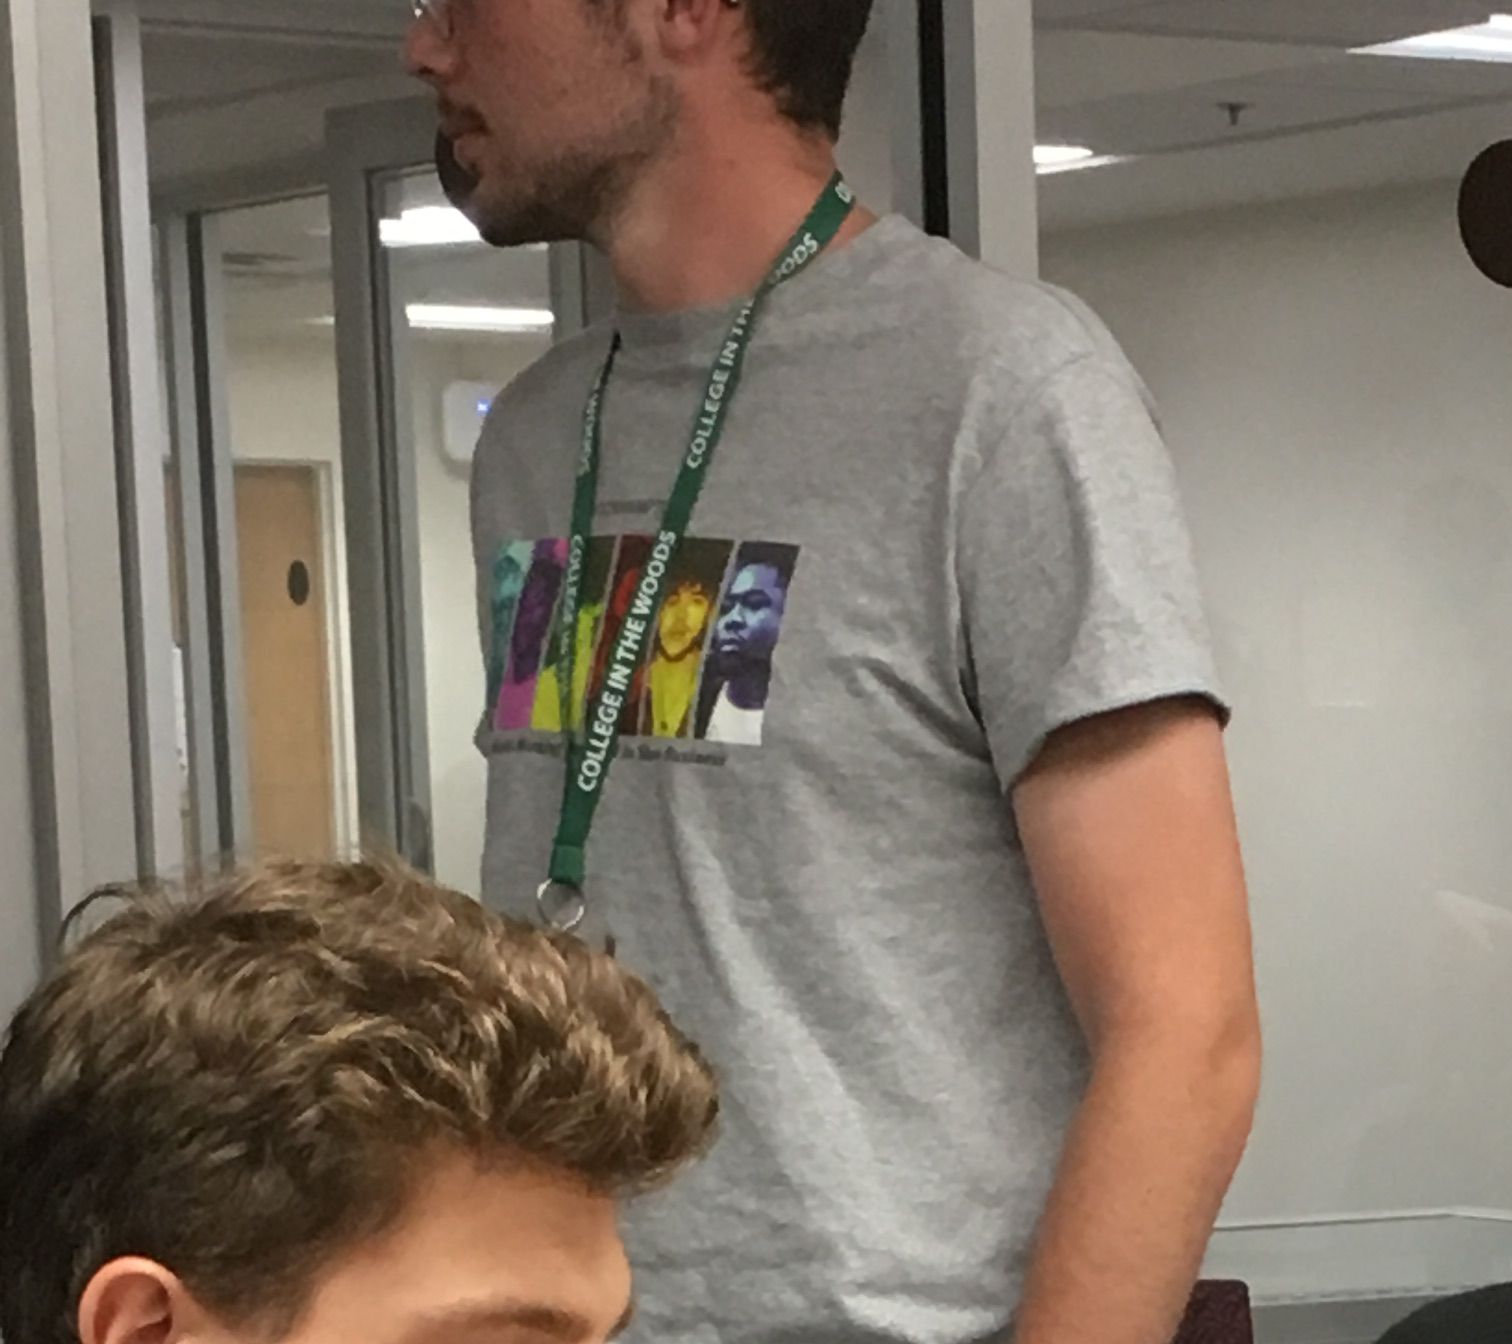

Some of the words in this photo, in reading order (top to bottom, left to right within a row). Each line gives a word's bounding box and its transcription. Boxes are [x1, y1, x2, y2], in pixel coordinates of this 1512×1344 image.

[686, 369, 730, 469] COLLEGE
[719, 339, 740, 366] IN
[631, 530, 677, 615] WOODS
[609, 663, 631, 692] IN
[616, 616, 648, 661] THE
[577, 691, 622, 792] COLLEGE
